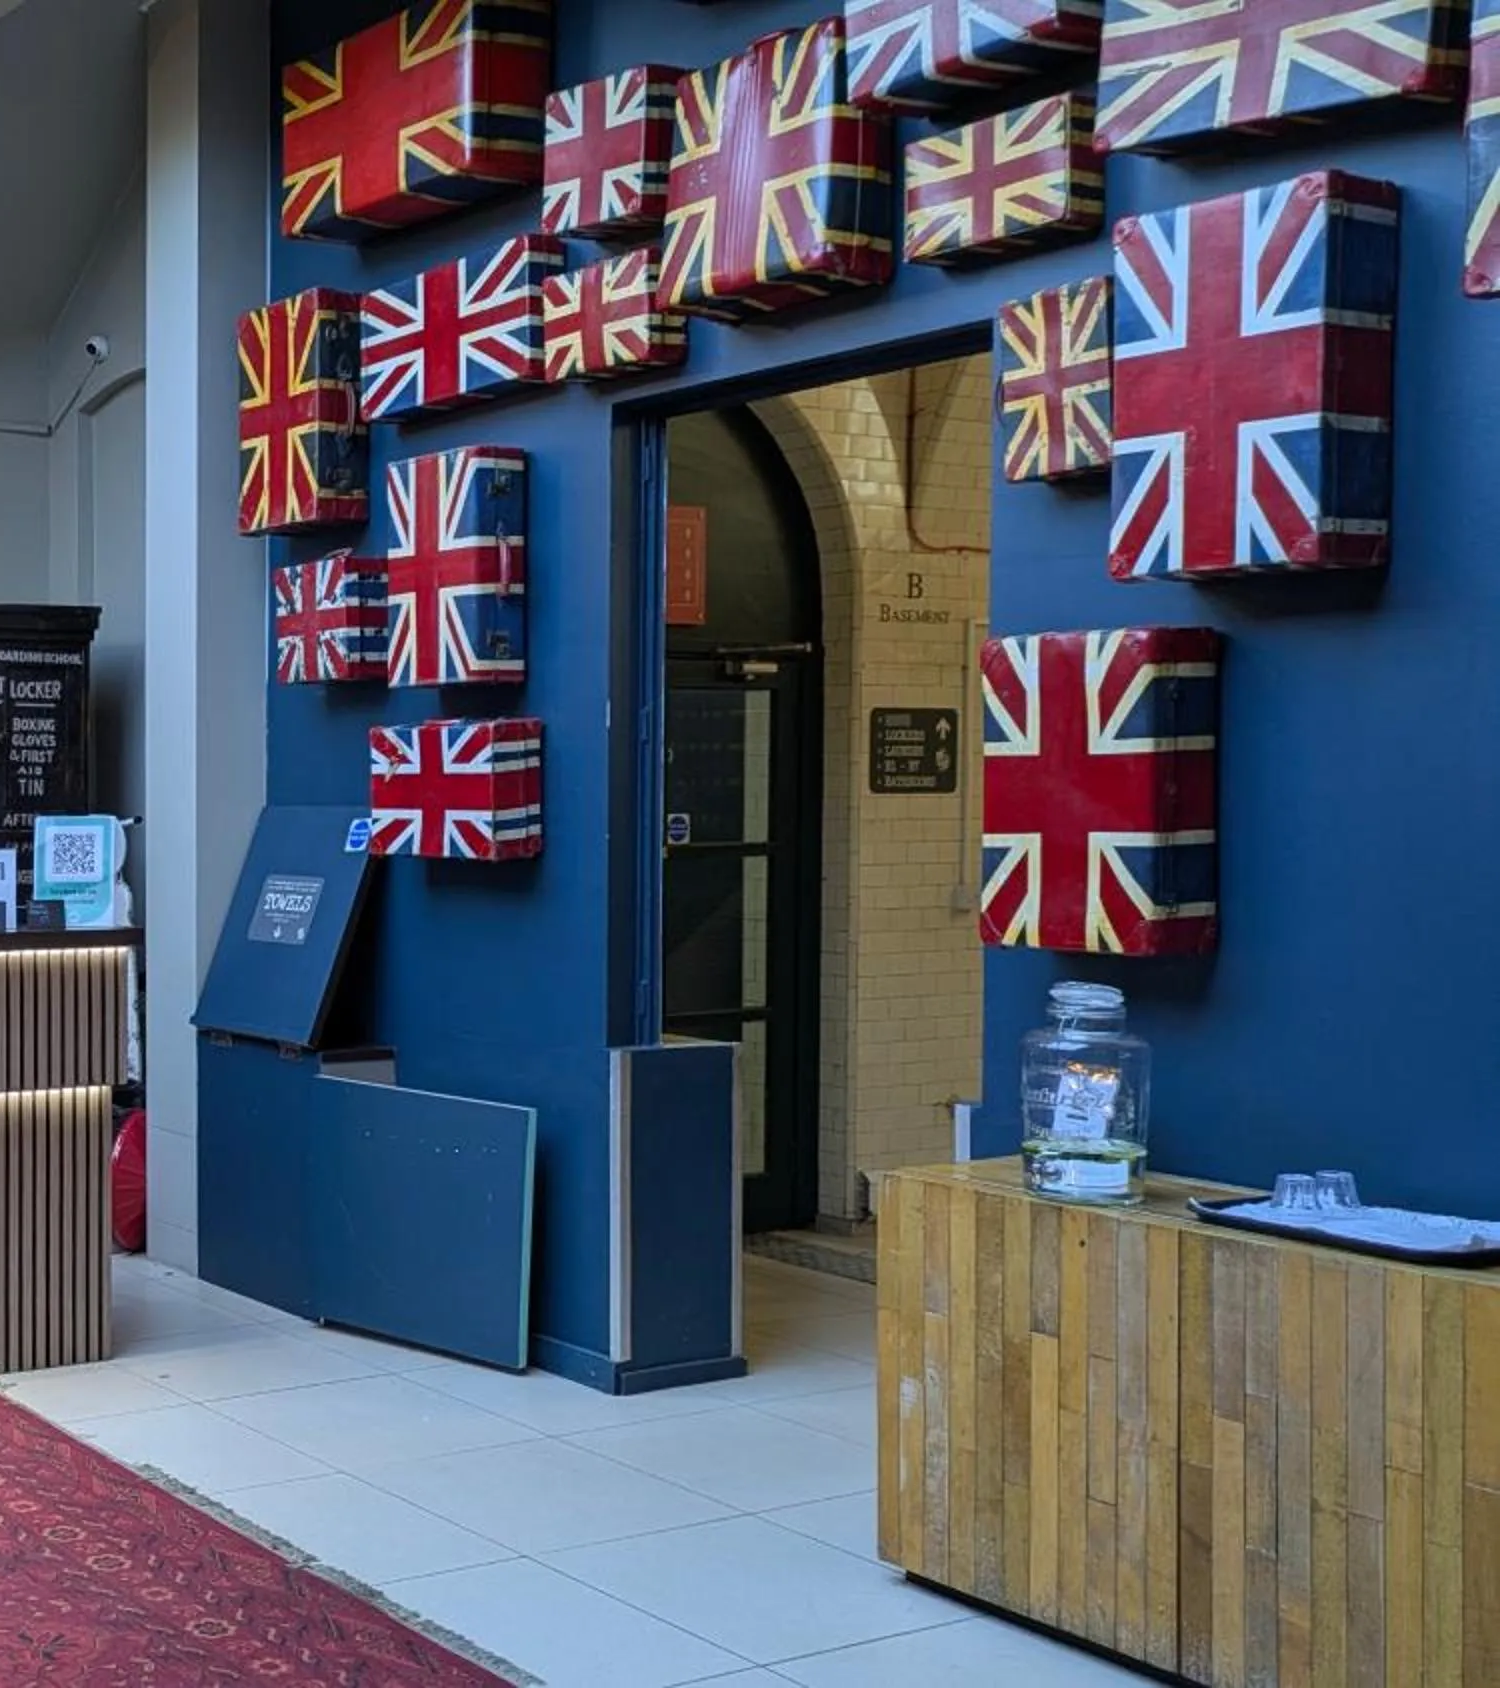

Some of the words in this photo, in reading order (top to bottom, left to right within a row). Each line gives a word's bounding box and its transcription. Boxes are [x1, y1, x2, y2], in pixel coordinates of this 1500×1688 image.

[907, 573, 923, 599] B
[9, 680, 61, 700] LOCKER
[11, 717, 56, 731] BOXING
[11, 734, 57, 747] GLOVES
[17, 765, 43, 775] AID
[17, 779, 45, 797] TIN
[263, 893, 313, 912] TOWELS
